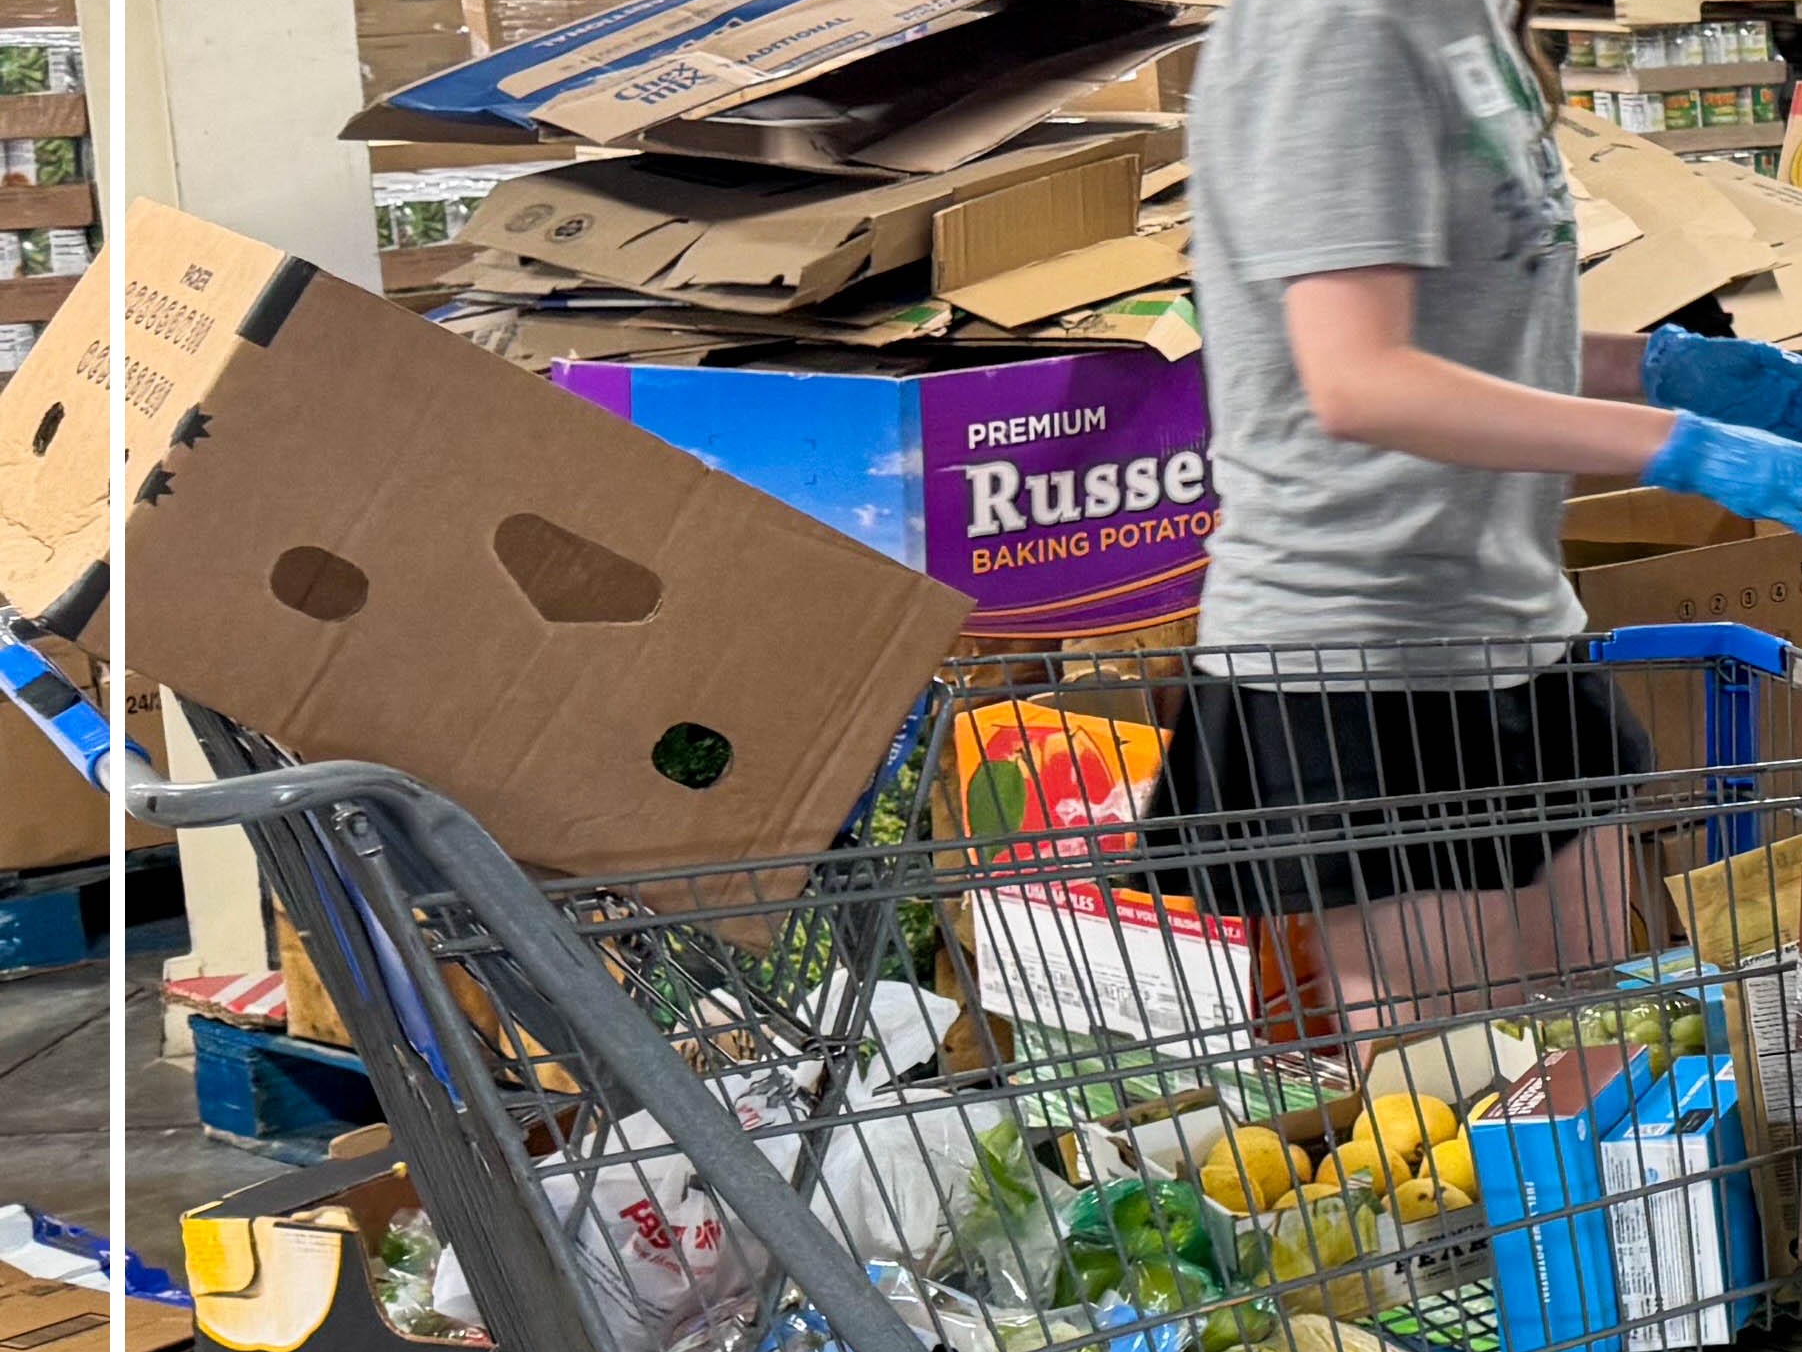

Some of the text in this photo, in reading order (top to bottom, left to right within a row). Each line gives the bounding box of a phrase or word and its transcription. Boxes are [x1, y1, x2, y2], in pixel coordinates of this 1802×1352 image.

[614, 62, 693, 103] Chex
[639, 67, 707, 106] mix
[968, 405, 1106, 450] PREMIUM
[972, 532, 1090, 574] BAKING
